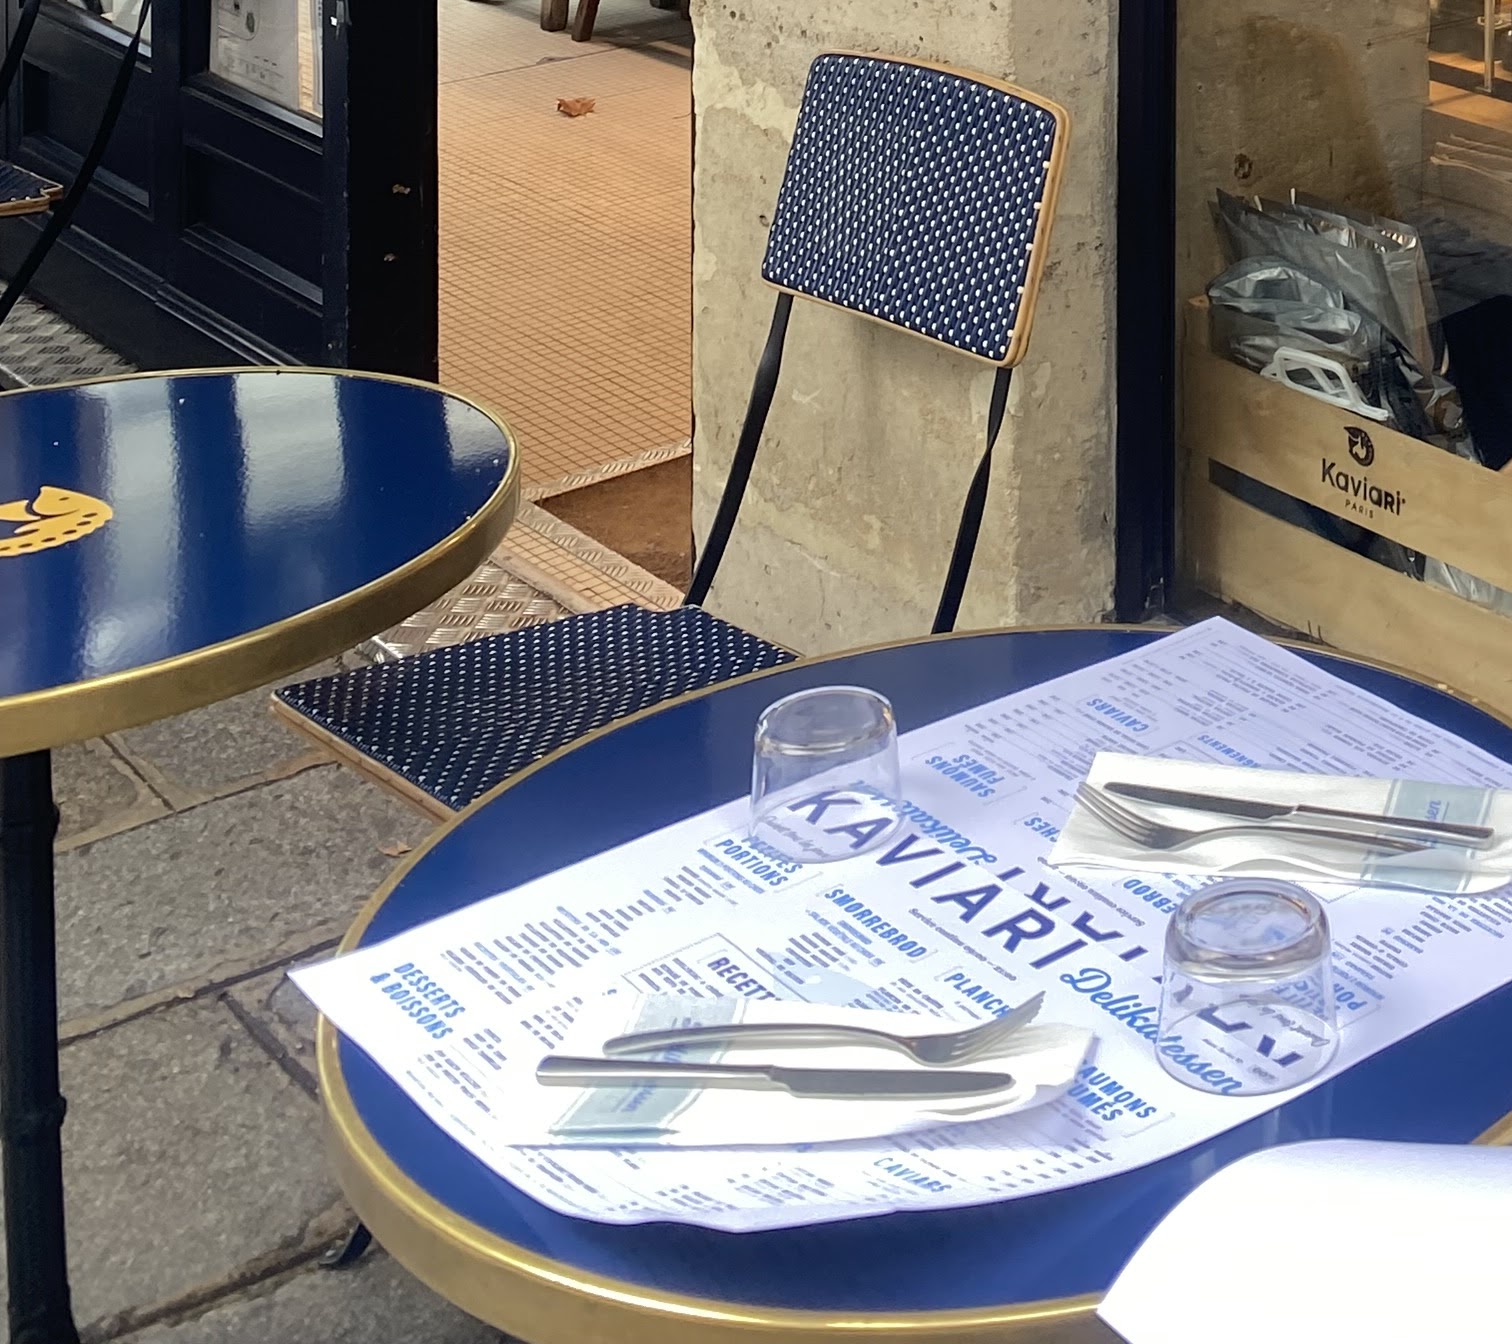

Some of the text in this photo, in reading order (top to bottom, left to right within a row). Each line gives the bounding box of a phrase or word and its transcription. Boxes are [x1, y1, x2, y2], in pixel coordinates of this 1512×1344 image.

[1344, 499, 1374, 519] PARIS
[1085, 698, 1149, 733] CAVIARS
[923, 755, 998, 799] SAUMONS
[714, 838, 789, 888] PORTIONS
[788, 790, 1089, 971] KAVIARI
[381, 980, 454, 1040] BOISSONS
[392, 961, 466, 1019] DESSERTS
[1059, 967, 1245, 1095] Delikatessen
[1066, 1077, 1124, 1123] UMÉS
[1082, 1062, 1159, 1121] AUMONS
